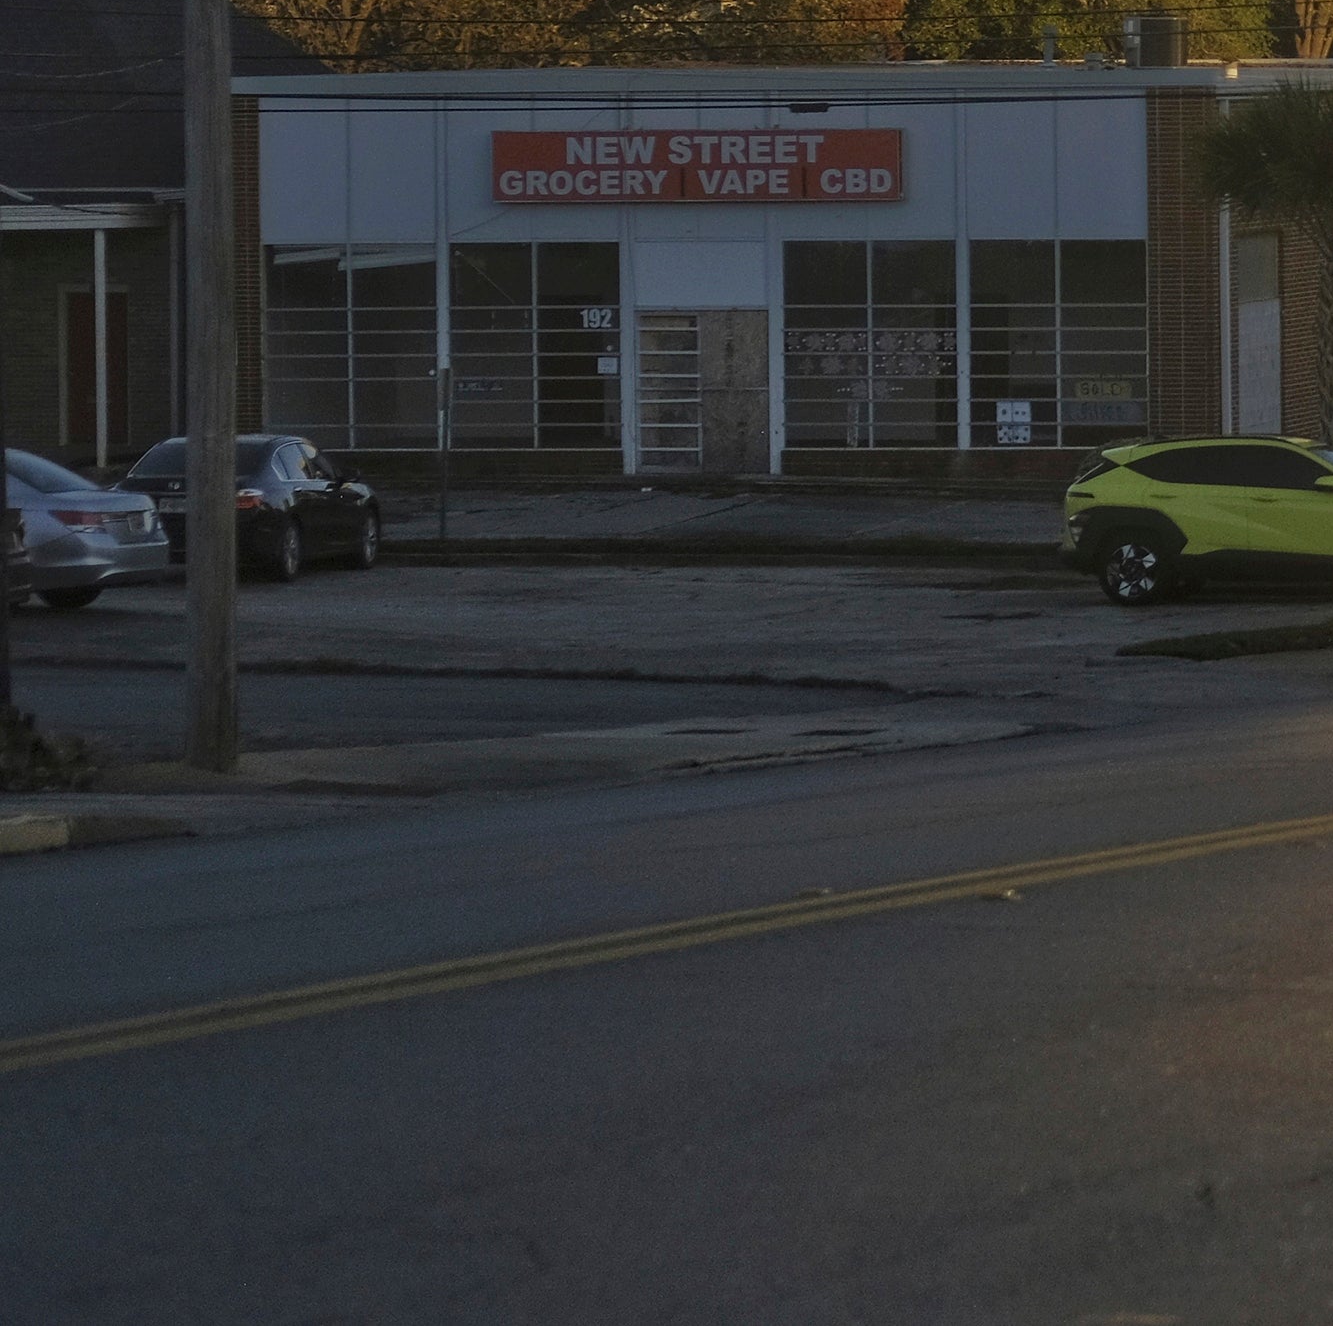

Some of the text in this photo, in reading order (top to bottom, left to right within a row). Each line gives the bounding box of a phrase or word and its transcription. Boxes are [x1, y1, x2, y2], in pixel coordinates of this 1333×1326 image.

[565, 135, 825, 165] NEW STREET
[500, 168, 893, 196] GROCERY VAPE CBD
[580, 308, 612, 328] 192
